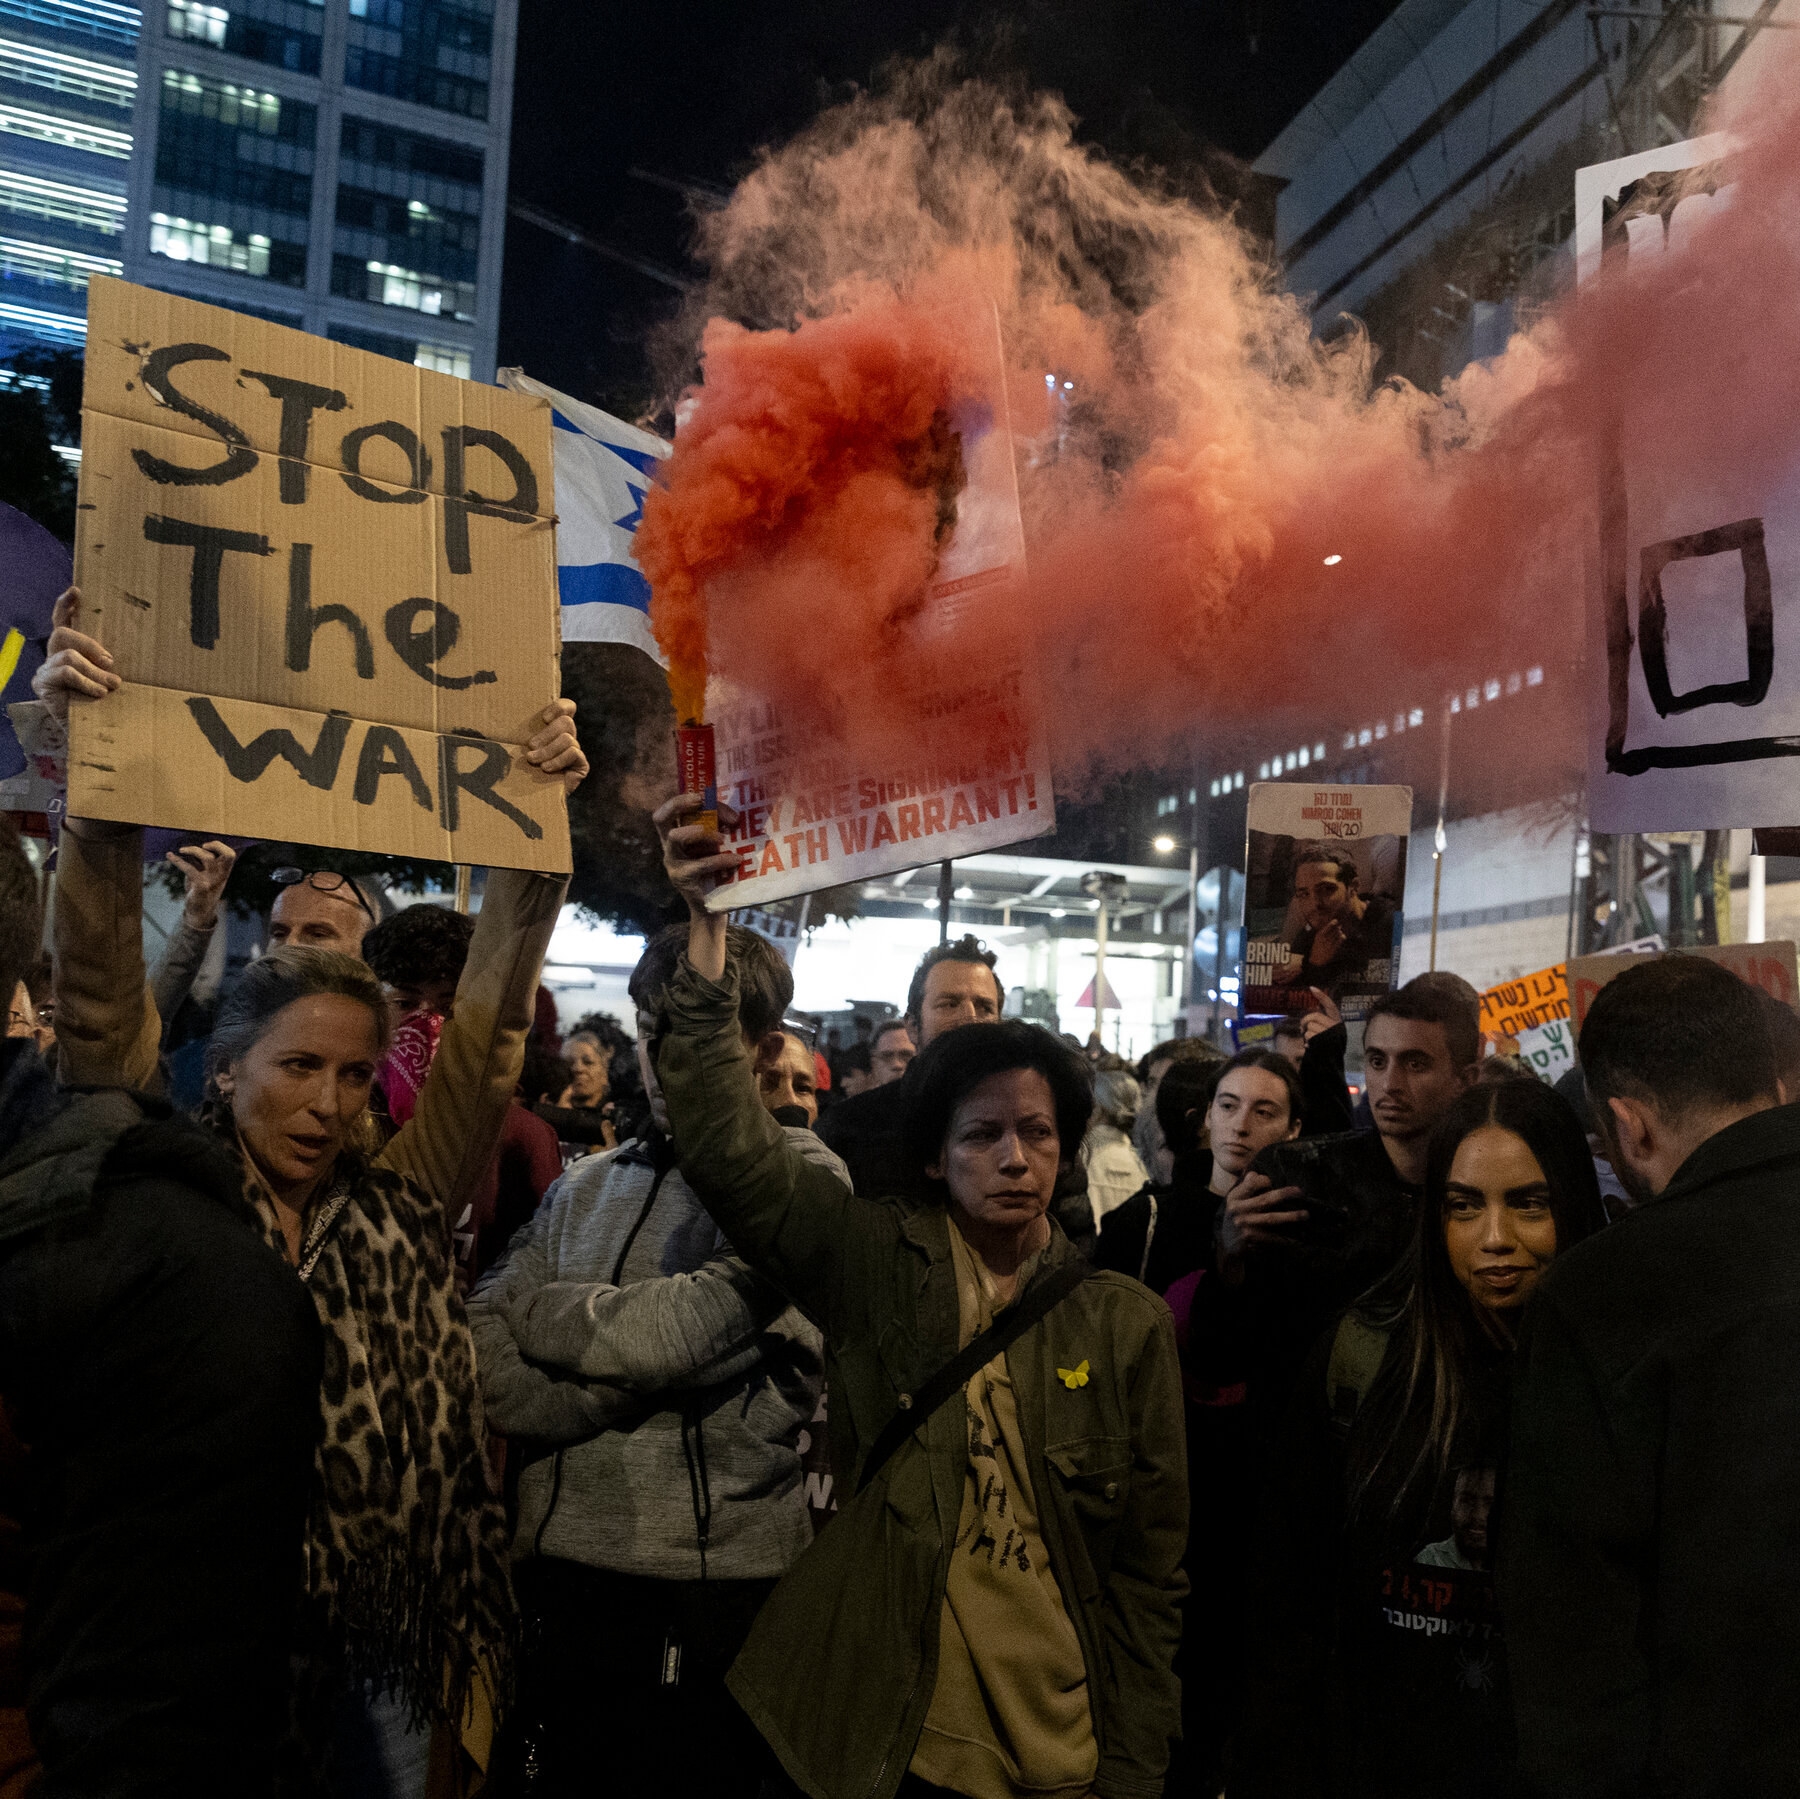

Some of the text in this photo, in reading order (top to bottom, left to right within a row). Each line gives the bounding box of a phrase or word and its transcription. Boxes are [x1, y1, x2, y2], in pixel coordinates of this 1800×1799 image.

[131, 342, 539, 574] STOP
[143, 512, 497, 689] The
[186, 696, 543, 839] WAR
[686, 741, 695, 779] COLOR
[730, 803, 783, 843] HEY
[792, 783, 852, 828] ARE
[836, 773, 1038, 857] WARRANT!
[1245, 963, 1273, 987] HIM
[1246, 941, 1290, 964] BRING
